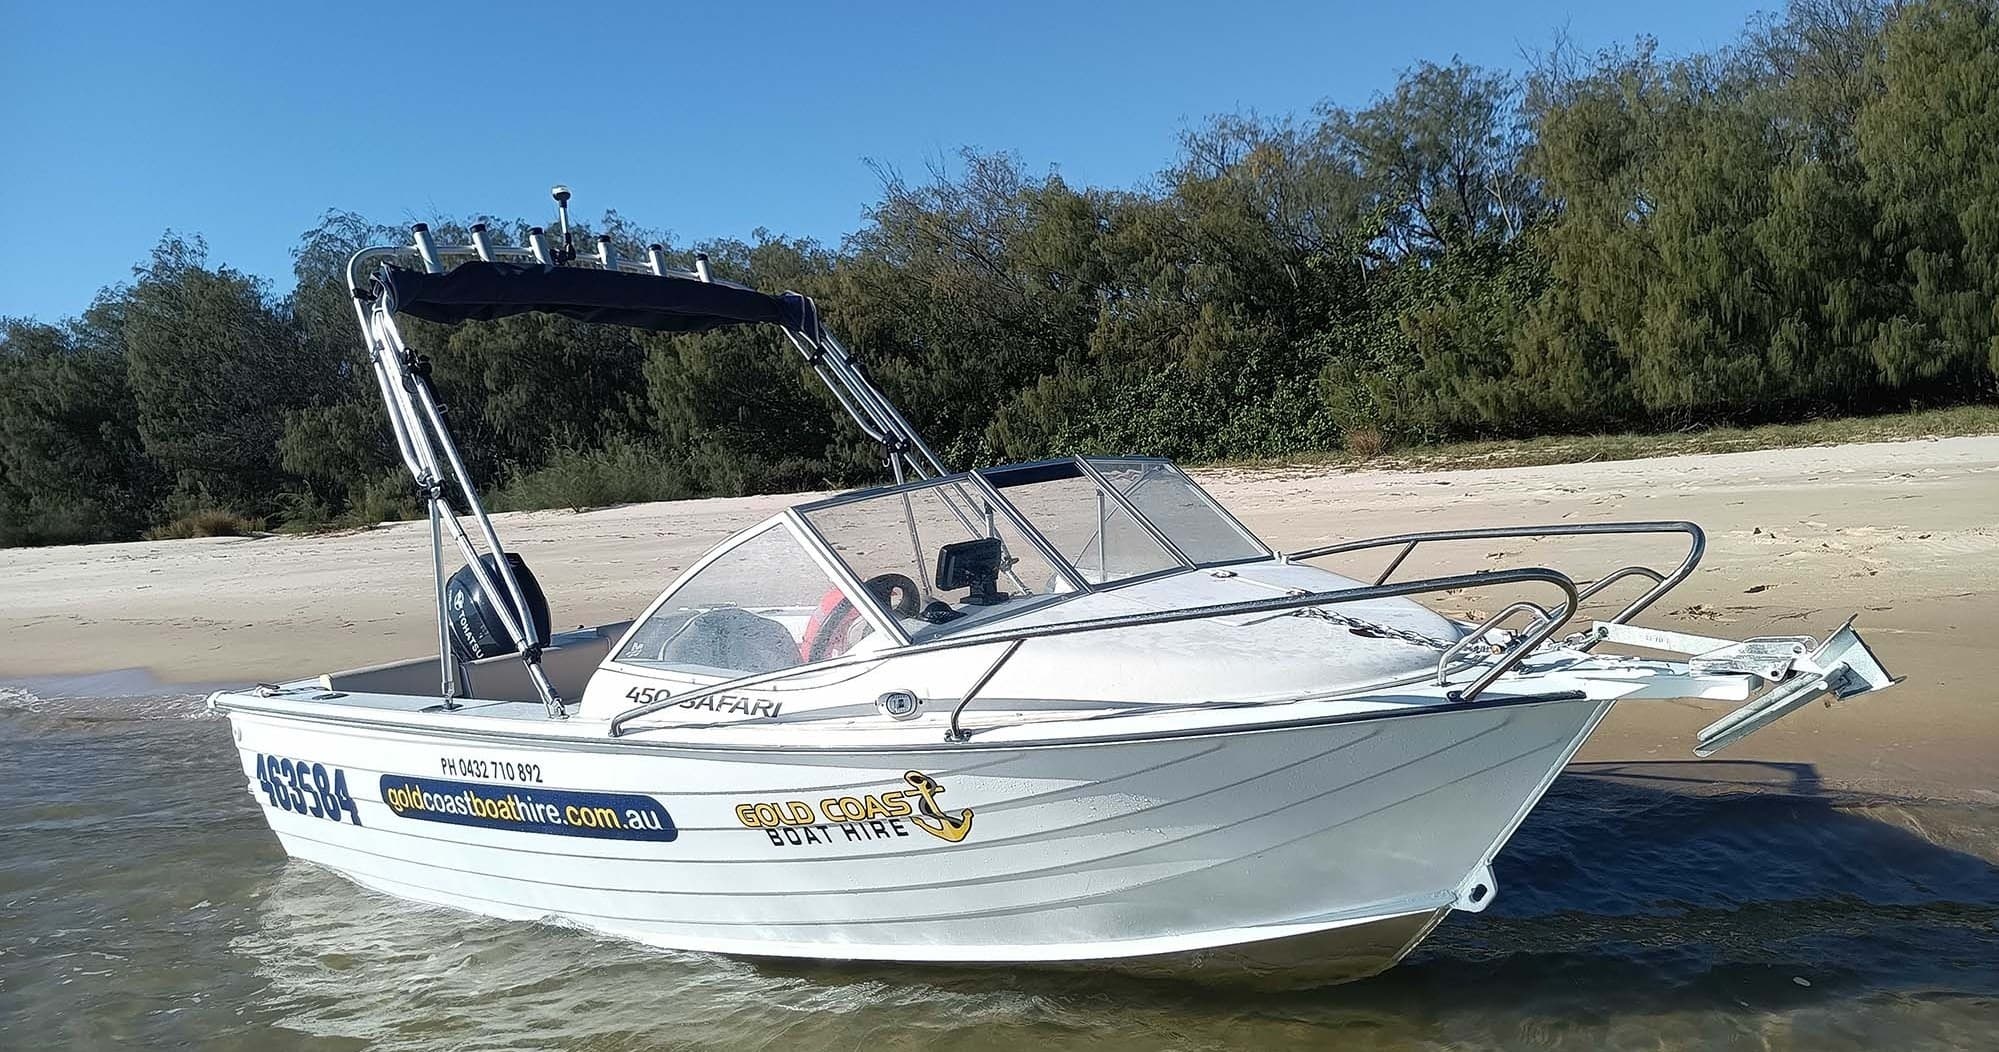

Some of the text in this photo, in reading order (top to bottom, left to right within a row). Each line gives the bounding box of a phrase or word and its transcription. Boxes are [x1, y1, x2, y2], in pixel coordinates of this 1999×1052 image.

[458, 609, 484, 659] TOHATSU
[440, 757, 544, 783] PH 0432 710 892
[256, 753, 363, 826] 463584
[387, 783, 664, 831] goldcoastboathire.com.au
[735, 801, 816, 828] GOLD
[766, 818, 909, 847] BOAT HIRE
